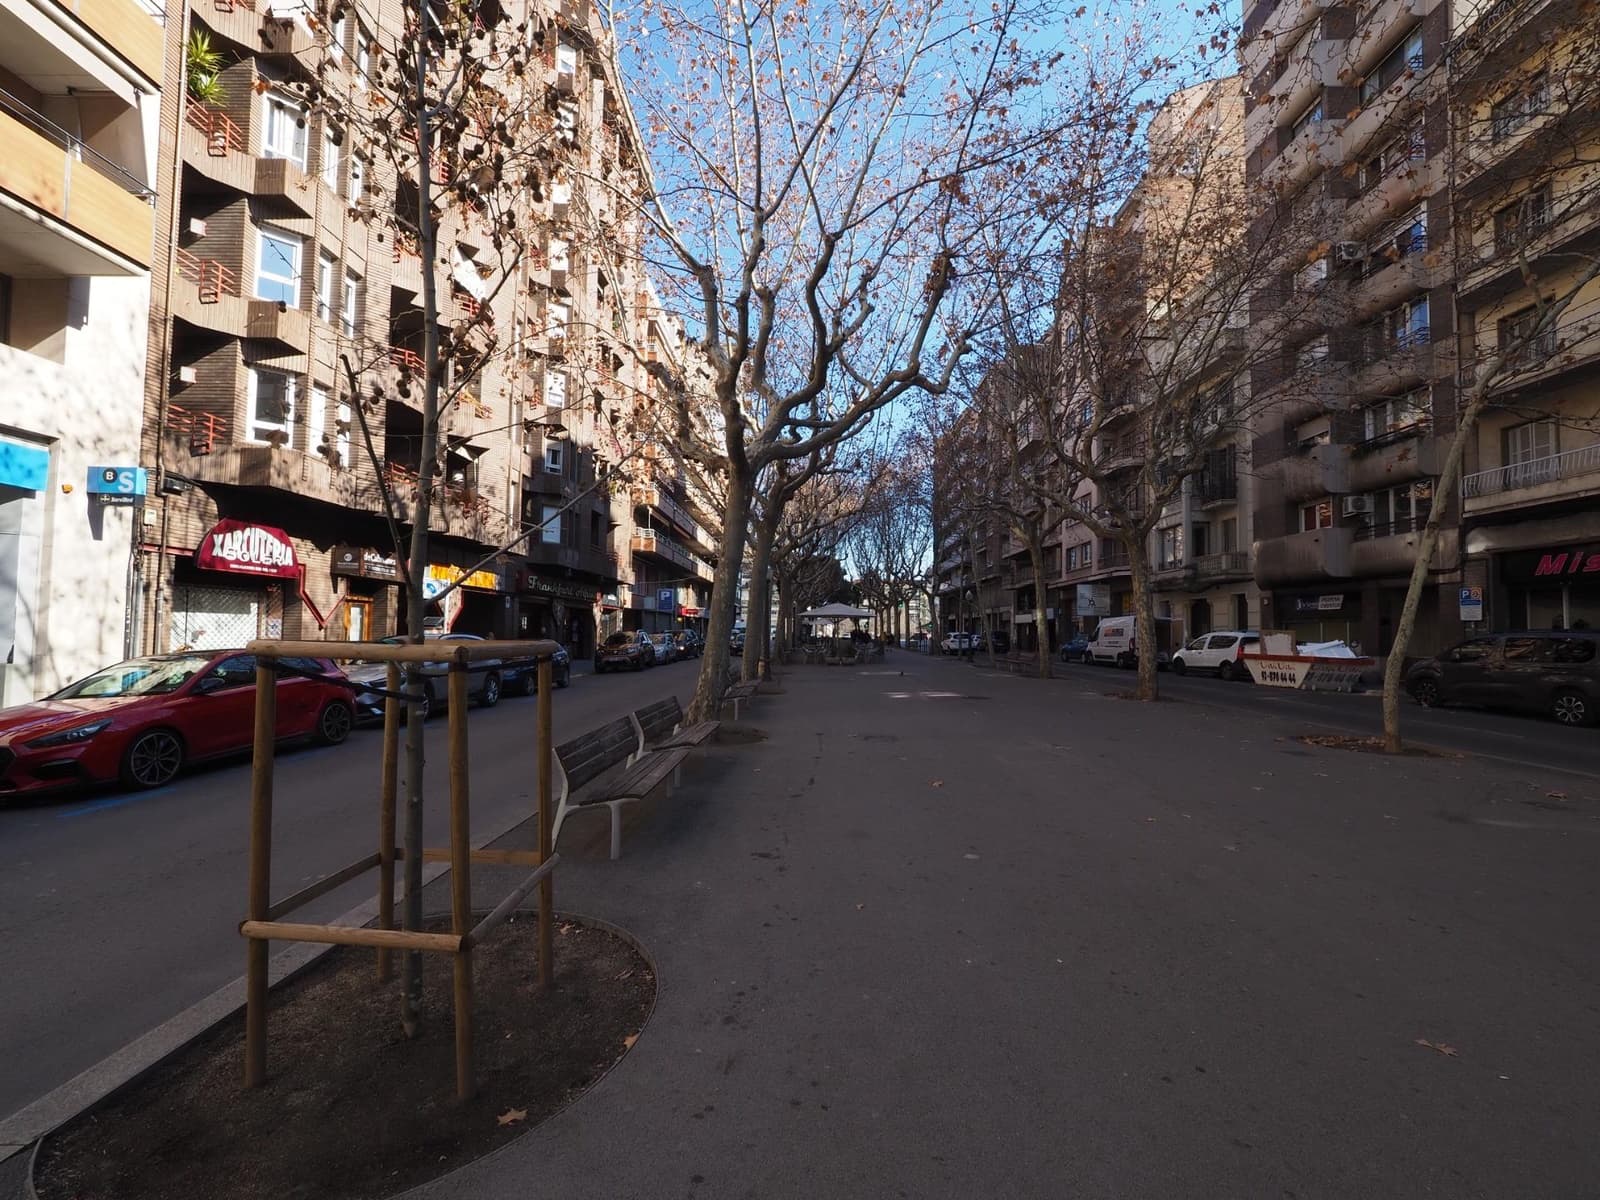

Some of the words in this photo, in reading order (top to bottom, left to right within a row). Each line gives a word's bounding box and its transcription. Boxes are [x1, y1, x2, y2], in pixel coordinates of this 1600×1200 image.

[106, 471, 114, 480] B
[118, 471, 134, 493] S
[212, 527, 294, 567] XARCUTERIA
[660, 591, 671, 601] P
[1462, 590, 1470, 599] P
